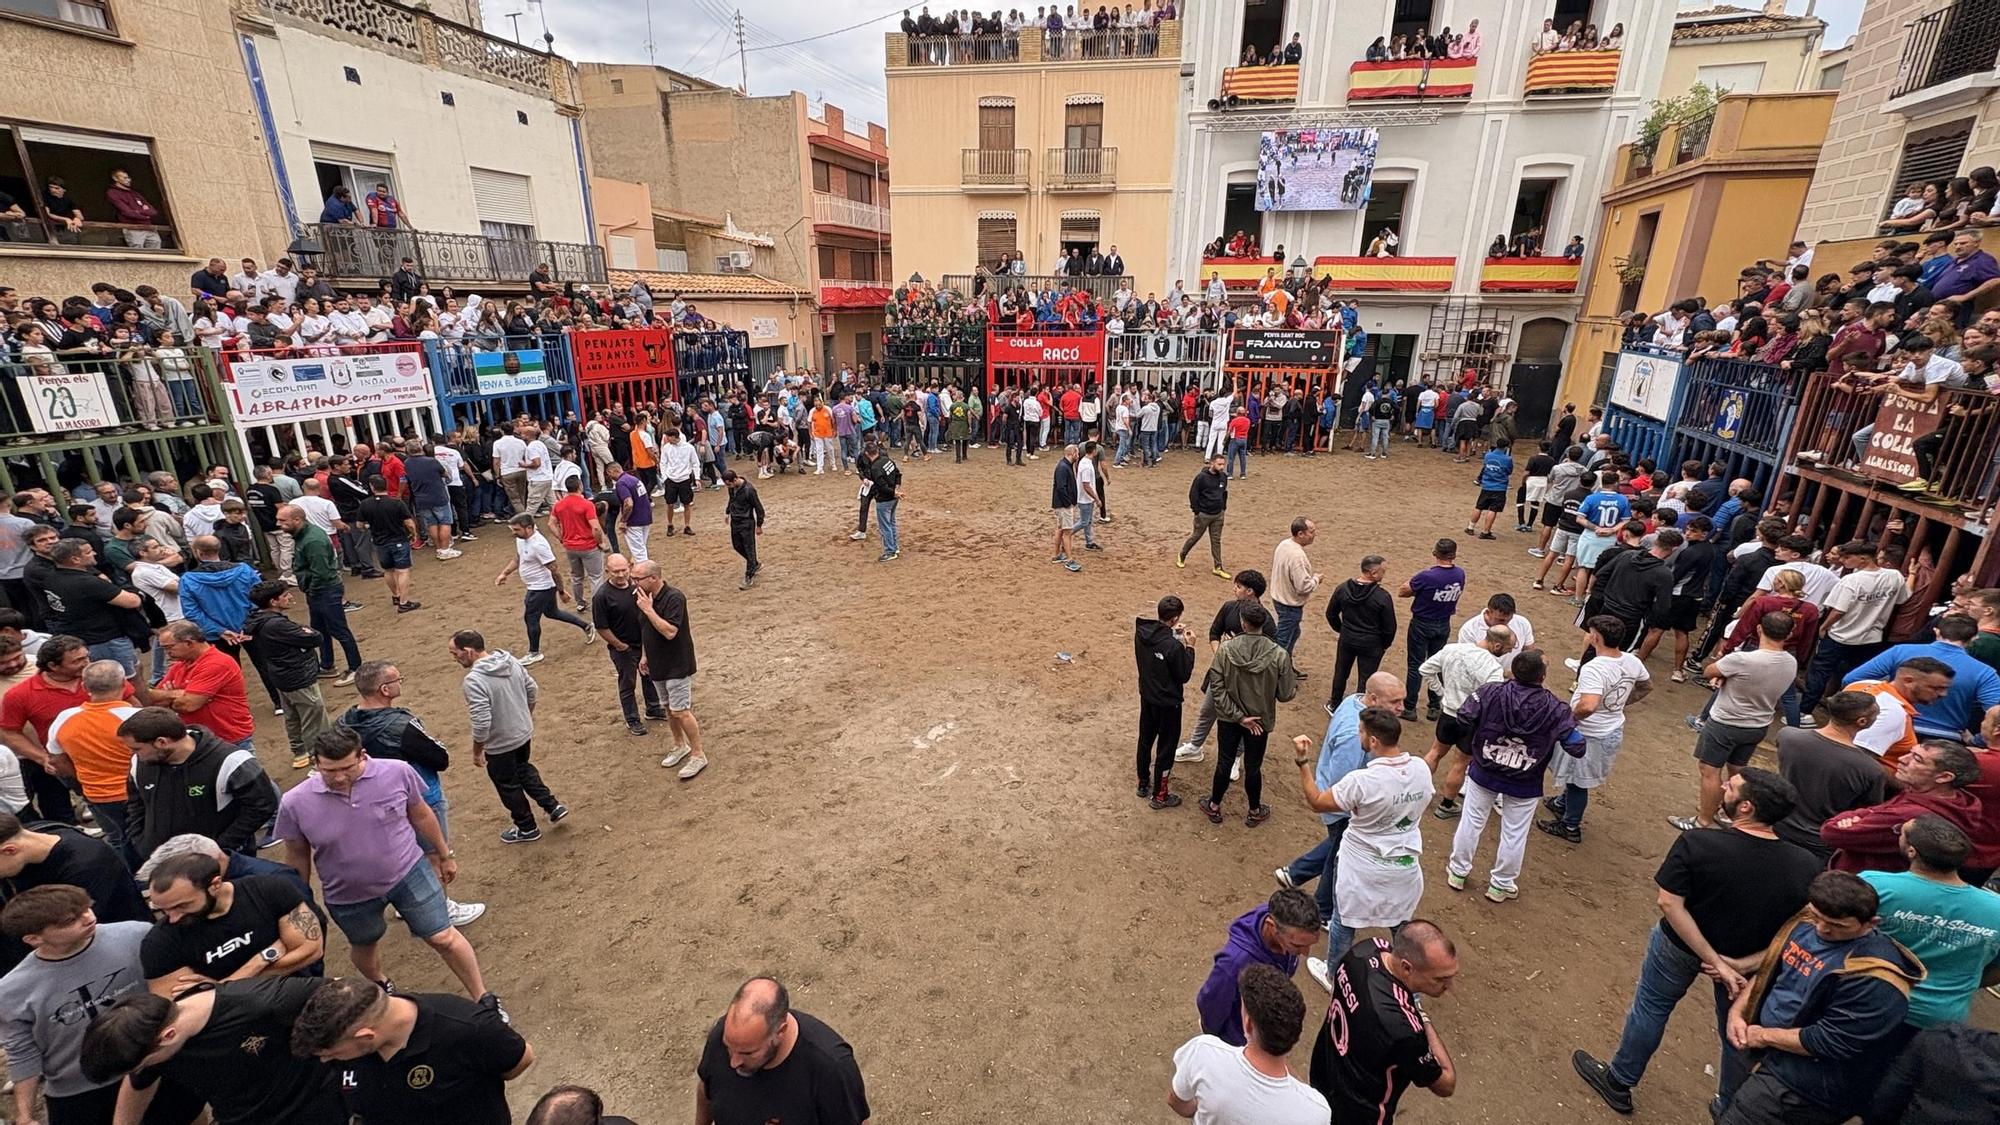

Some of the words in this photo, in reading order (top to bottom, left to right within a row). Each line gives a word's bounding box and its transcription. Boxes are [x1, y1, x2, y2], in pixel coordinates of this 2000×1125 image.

[584, 338, 636, 349] PENJATS
[1010, 338, 1043, 348] COLLA
[1246, 340, 1321, 349] FRANAUTO
[588, 351, 602, 361] 35
[607, 350, 636, 360] ANYS
[1043, 345, 1080, 361] RACÓ
[586, 363, 603, 371] AMB
[606, 362, 615, 370] LA
[617, 361, 640, 370] FESTA
[37, 376, 72, 387] Penya
[73, 375, 89, 384] els
[360, 377, 397, 386] INDALO
[480, 379, 503, 390] PENYA
[505, 379, 512, 388] EL
[514, 375, 546, 386] BARRILET
[249, 393, 382, 415] ABRAPIND.com
[55, 418, 102, 430] ALMASSORA
[1893, 413, 1915, 433] LA
[1871, 431, 1916, 456] COLL
[1865, 456, 1916, 477] ALMASSORA
[1598, 506, 1619, 527] 10
[1893, 910, 1932, 923] WORK
[1947, 919, 1998, 937] SILENCE
[206, 932, 251, 964] HSN
[1336, 963, 1360, 1014] MESSI
